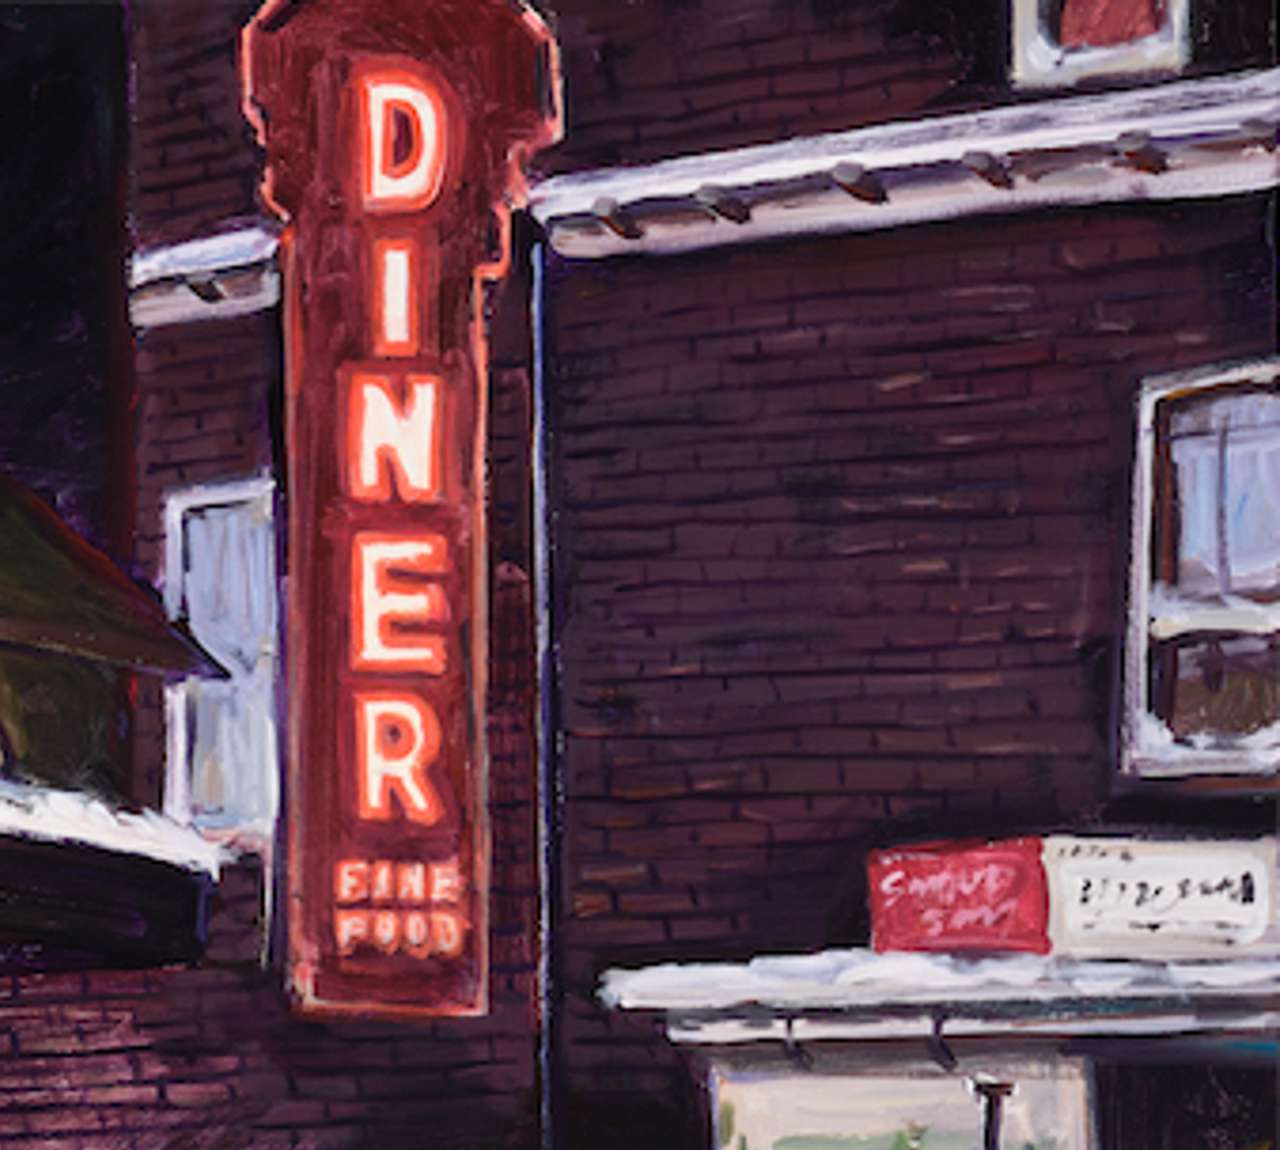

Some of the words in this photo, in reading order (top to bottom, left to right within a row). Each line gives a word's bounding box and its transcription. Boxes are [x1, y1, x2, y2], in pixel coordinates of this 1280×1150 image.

[348, 70, 446, 822] DINER
[337, 860, 460, 901] FINE
[337, 911, 462, 956] FOOD
